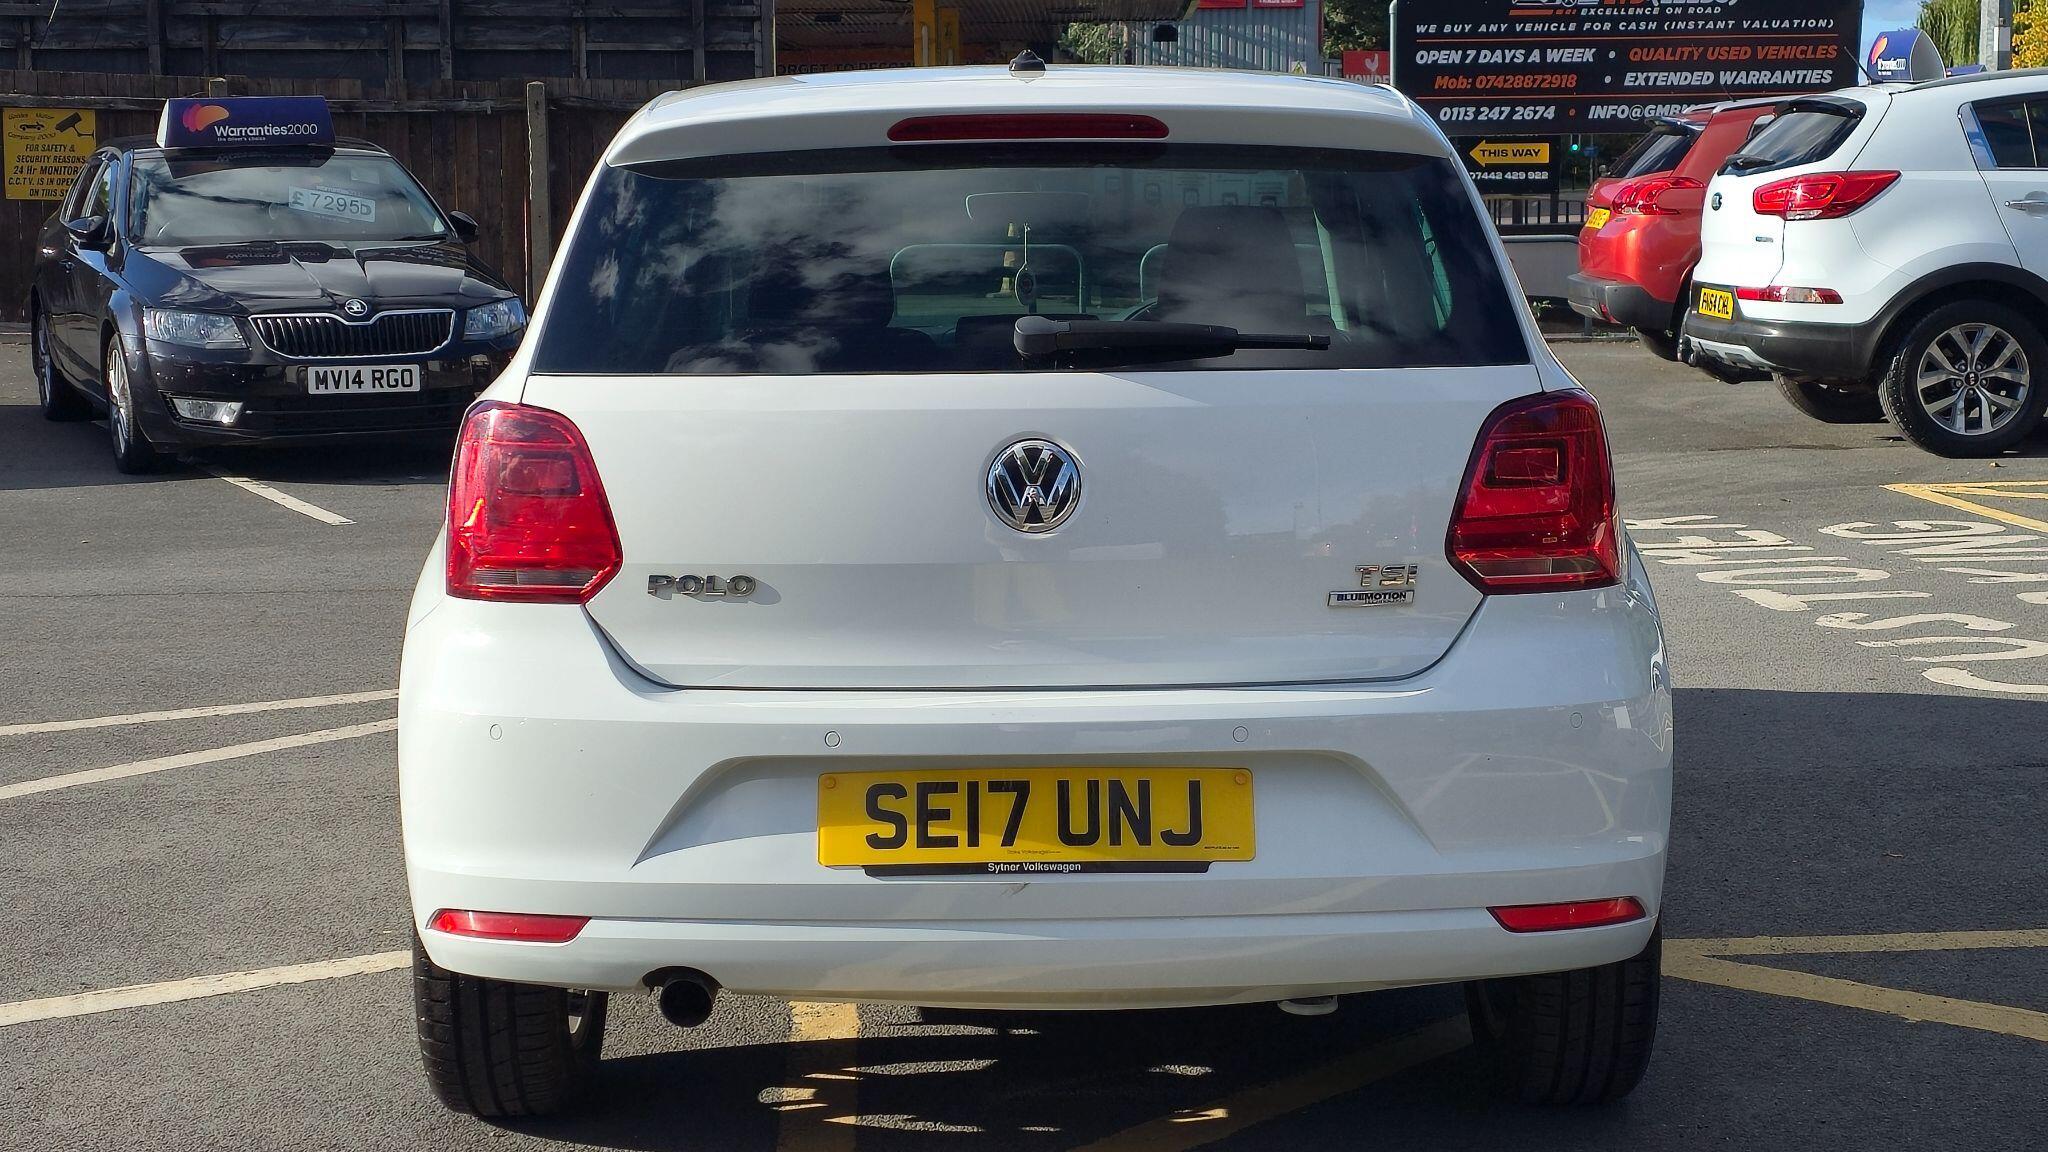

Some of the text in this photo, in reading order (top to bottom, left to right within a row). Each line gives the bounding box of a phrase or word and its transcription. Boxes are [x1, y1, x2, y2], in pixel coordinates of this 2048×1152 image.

[1580, 7, 1661, 15] EXCELLENCE
[1688, 6, 1722, 14] ROAD
[1416, 19, 1834, 33] WE BUY ANY VEHICLE FOR CASH (INSTANT VALUATION)
[1415, 48, 1597, 64] OPEN 7 DAYS A WEEK
[1628, 45, 1838, 62] QUALITY USED VEHICLES
[1434, 74, 1578, 89] Mob: 07428872918
[1623, 70, 1834, 86] EXTENDED WARRANTIES
[1439, 105, 1556, 121] 0113 247 2674
[1588, 103, 1694, 120] INFO@GMB
[214, 123, 318, 137] Warranties2000
[25, 144, 39, 152] FOR
[41, 144, 67, 152] SAFETY
[1480, 148, 1541, 157] THIS WAY
[16, 155, 86, 164] SECURITY REASONS
[13, 166, 81, 175] 24 Hr MONITOR
[29, 189, 39, 197] ON
[41, 189, 57, 197] THIS
[314, 368, 414, 390] MV14 RGO
[1354, 563, 1418, 587] TSI
[647, 574, 757, 597] POLO
[1336, 592, 1407, 602] BLUEMOTION
[864, 779, 1204, 850] SE17 UNJ
[987, 861, 1082, 874] Sytner Volkswagen
